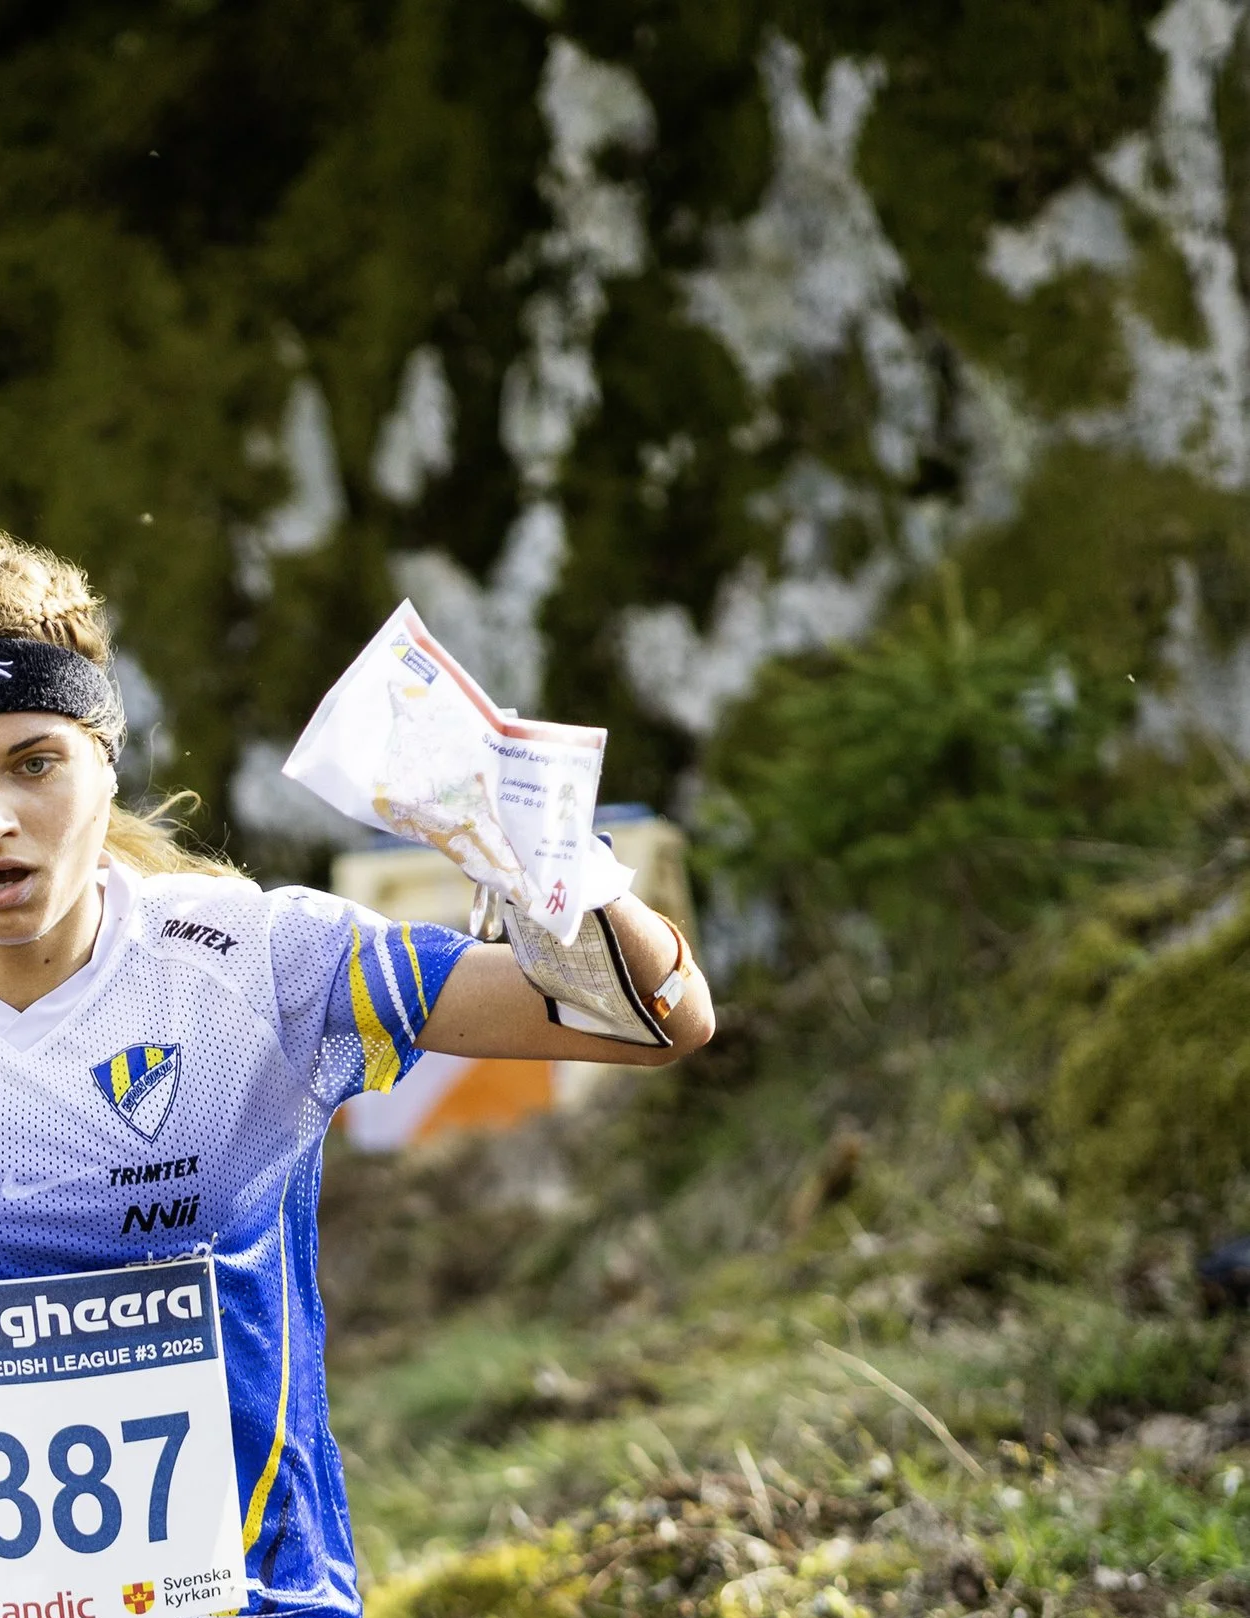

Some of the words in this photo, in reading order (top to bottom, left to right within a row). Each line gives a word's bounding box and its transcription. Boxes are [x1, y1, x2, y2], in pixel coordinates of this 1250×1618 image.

[482, 733, 528, 760] Swedish
[500, 792, 546, 809] 2025-05-01
[160, 919, 239, 956] TRIMTEX
[110, 1155, 200, 1187] TRIMTEX
[52, 1347, 131, 1373] LEAGUE
[135, 1343, 158, 1363] #3
[161, 1336, 204, 1358] 2025
[162, 1567, 232, 1592] Svenska
[164, 1585, 222, 1609] kyrkan
